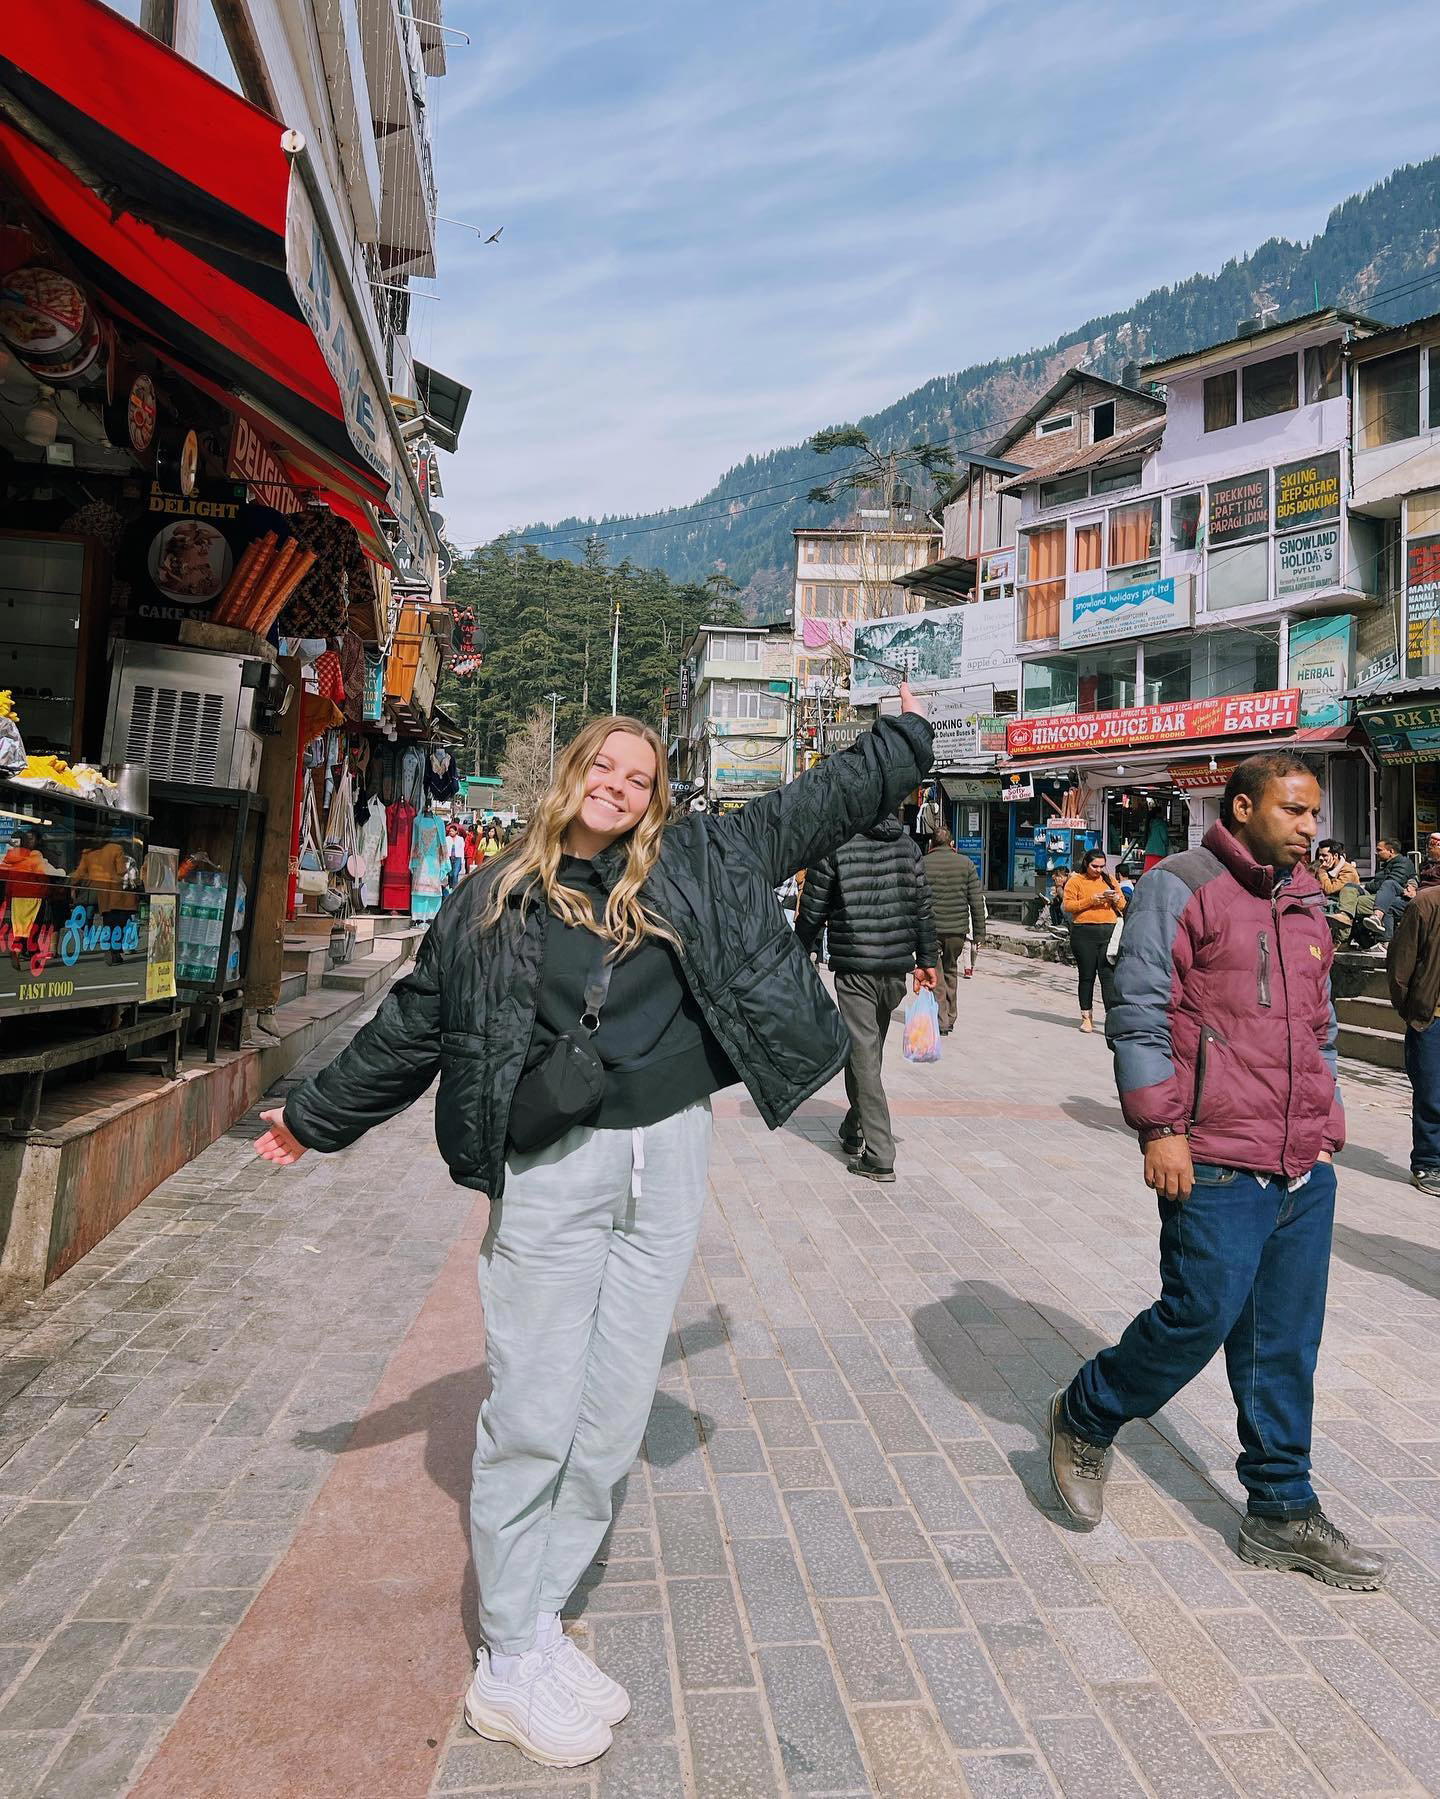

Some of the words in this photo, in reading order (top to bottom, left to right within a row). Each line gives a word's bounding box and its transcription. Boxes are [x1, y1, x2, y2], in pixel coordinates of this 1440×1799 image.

[1280, 468, 1317, 488] SKIING
[1214, 483, 1262, 505] TREKKING
[1280, 488, 1302, 503] JEEP
[1303, 478, 1337, 498] SAFARI
[149, 497, 239, 519] DELIGHT
[1215, 496, 1264, 519] RAFTING
[1277, 502, 1295, 518] BUS
[1297, 493, 1338, 513] BOOKING
[1280, 531, 1337, 554] SNOWLAND
[1075, 596, 1107, 610] snowland
[1109, 591, 1140, 604] holidays
[139, 605, 185, 620] CAKE
[1297, 666, 1335, 681] HERBAL
[1225, 695, 1295, 716] FRUIT
[1032, 722, 1099, 746] HIMCOOP
[1101, 716, 1149, 739] JUICE
[1151, 713, 1186, 734] BAR
[1224, 711, 1293, 732] BARFI
[1393, 710, 1423, 728] RK
[1036, 743, 1056, 751] APPLE
[1060, 741, 1081, 749] LITCHI
[1085, 739, 1104, 747] PLUM
[1108, 737, 1125, 745] KIWI
[1129, 734, 1155, 743] MANGO
[1176, 775, 1228, 787] FRUIT
[62, 905, 139, 967] Sweets
[19, 983, 46, 1000] FAST
[49, 981, 74, 998] FOOD
